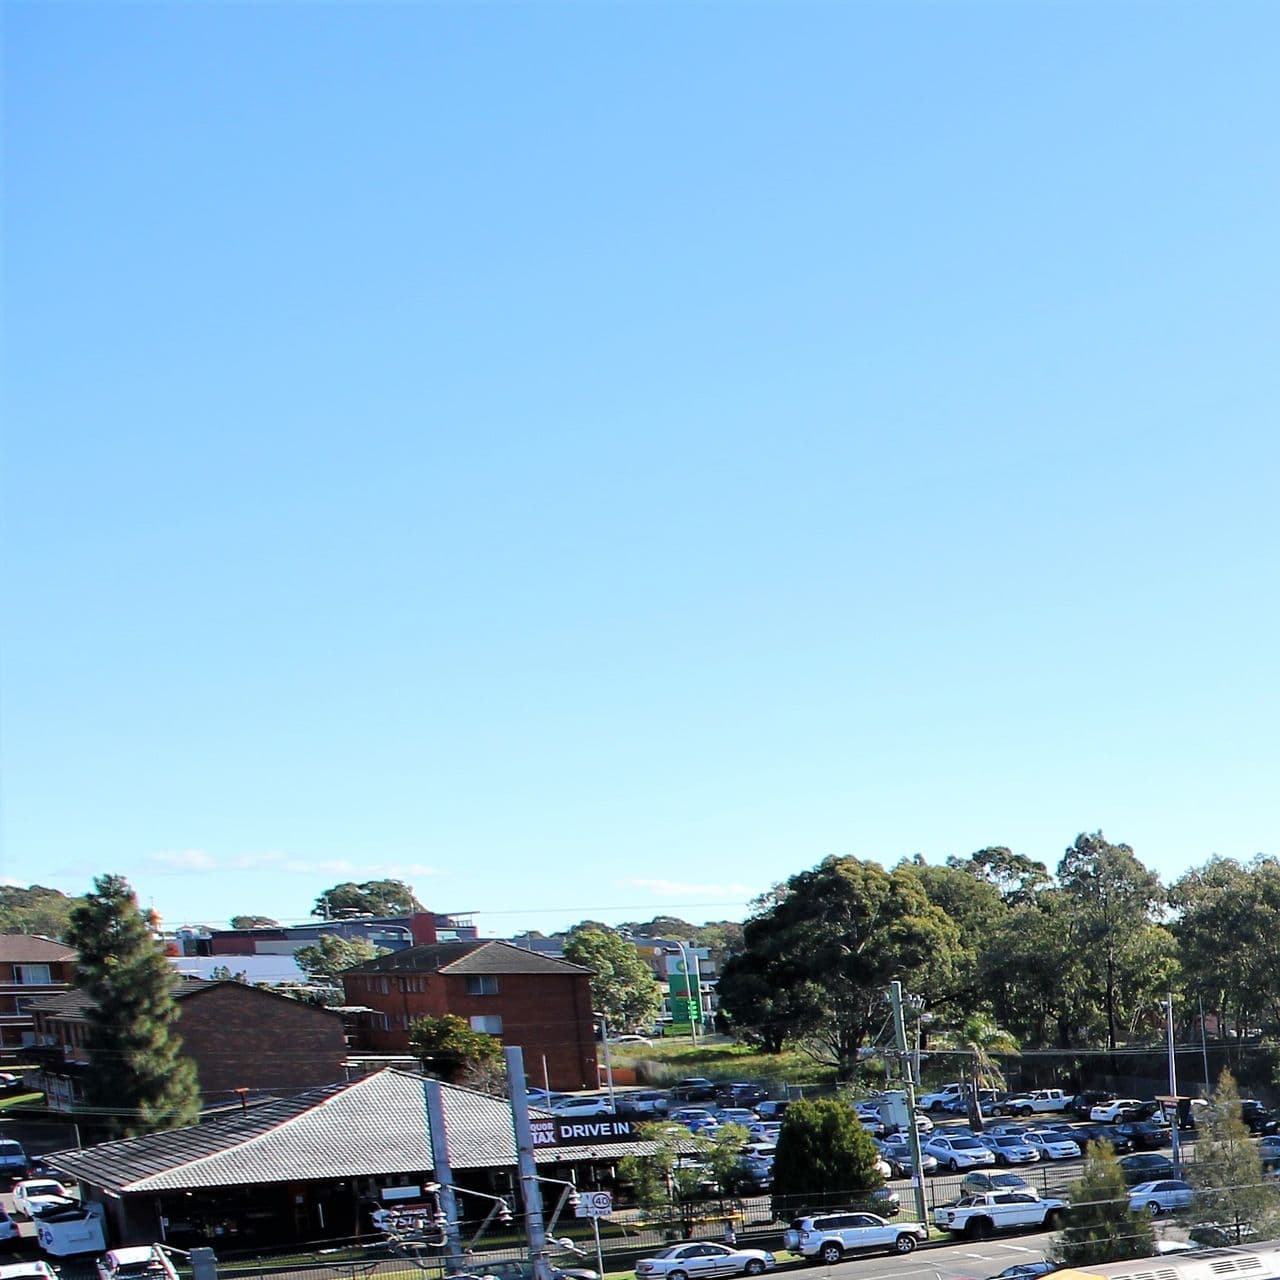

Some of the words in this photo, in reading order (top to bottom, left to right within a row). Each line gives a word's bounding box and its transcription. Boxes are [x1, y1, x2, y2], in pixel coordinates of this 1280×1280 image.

[530, 1122, 554, 1131] QUOR
[560, 1123, 611, 1138] DRIVE
[613, 1121, 630, 1135] IN
[530, 1131, 557, 1144] TAX
[595, 1196, 609, 1206] 40
